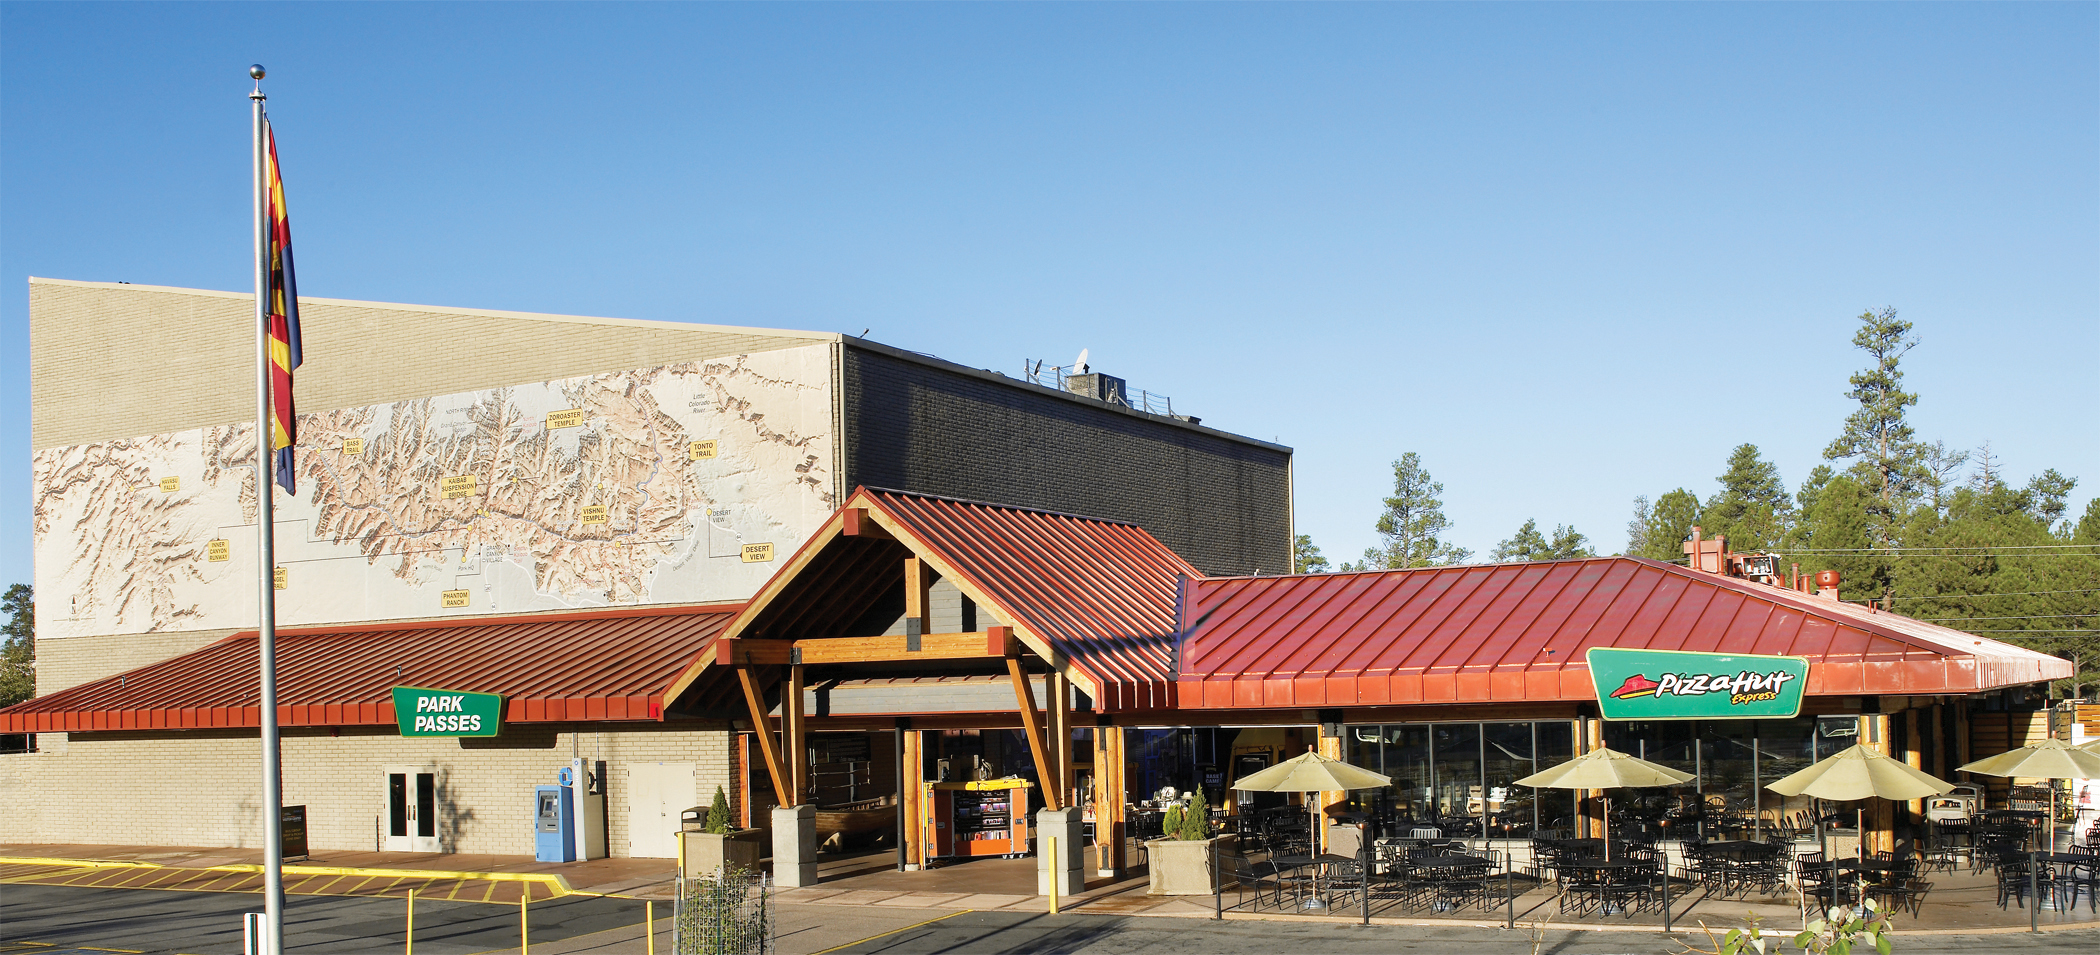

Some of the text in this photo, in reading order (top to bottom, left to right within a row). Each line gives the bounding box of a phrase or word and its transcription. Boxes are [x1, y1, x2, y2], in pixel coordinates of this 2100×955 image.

[549, 411, 581, 421] ZOROASTER
[554, 419, 575, 427] TEMPLE
[694, 442, 714, 450] TONTO
[448, 476, 467, 484] KAIBAB
[441, 483, 474, 492] SUSPENSION
[448, 490, 467, 498] BRIDGE
[582, 507, 605, 515] VISHNU
[712, 509, 731, 517] DESERT
[582, 514, 605, 522] TEMPLE
[745, 545, 770, 553] DESERT
[1731, 691, 1777, 705] Express
[416, 695, 465, 713] PARK
[414, 714, 482, 732] PASSES
